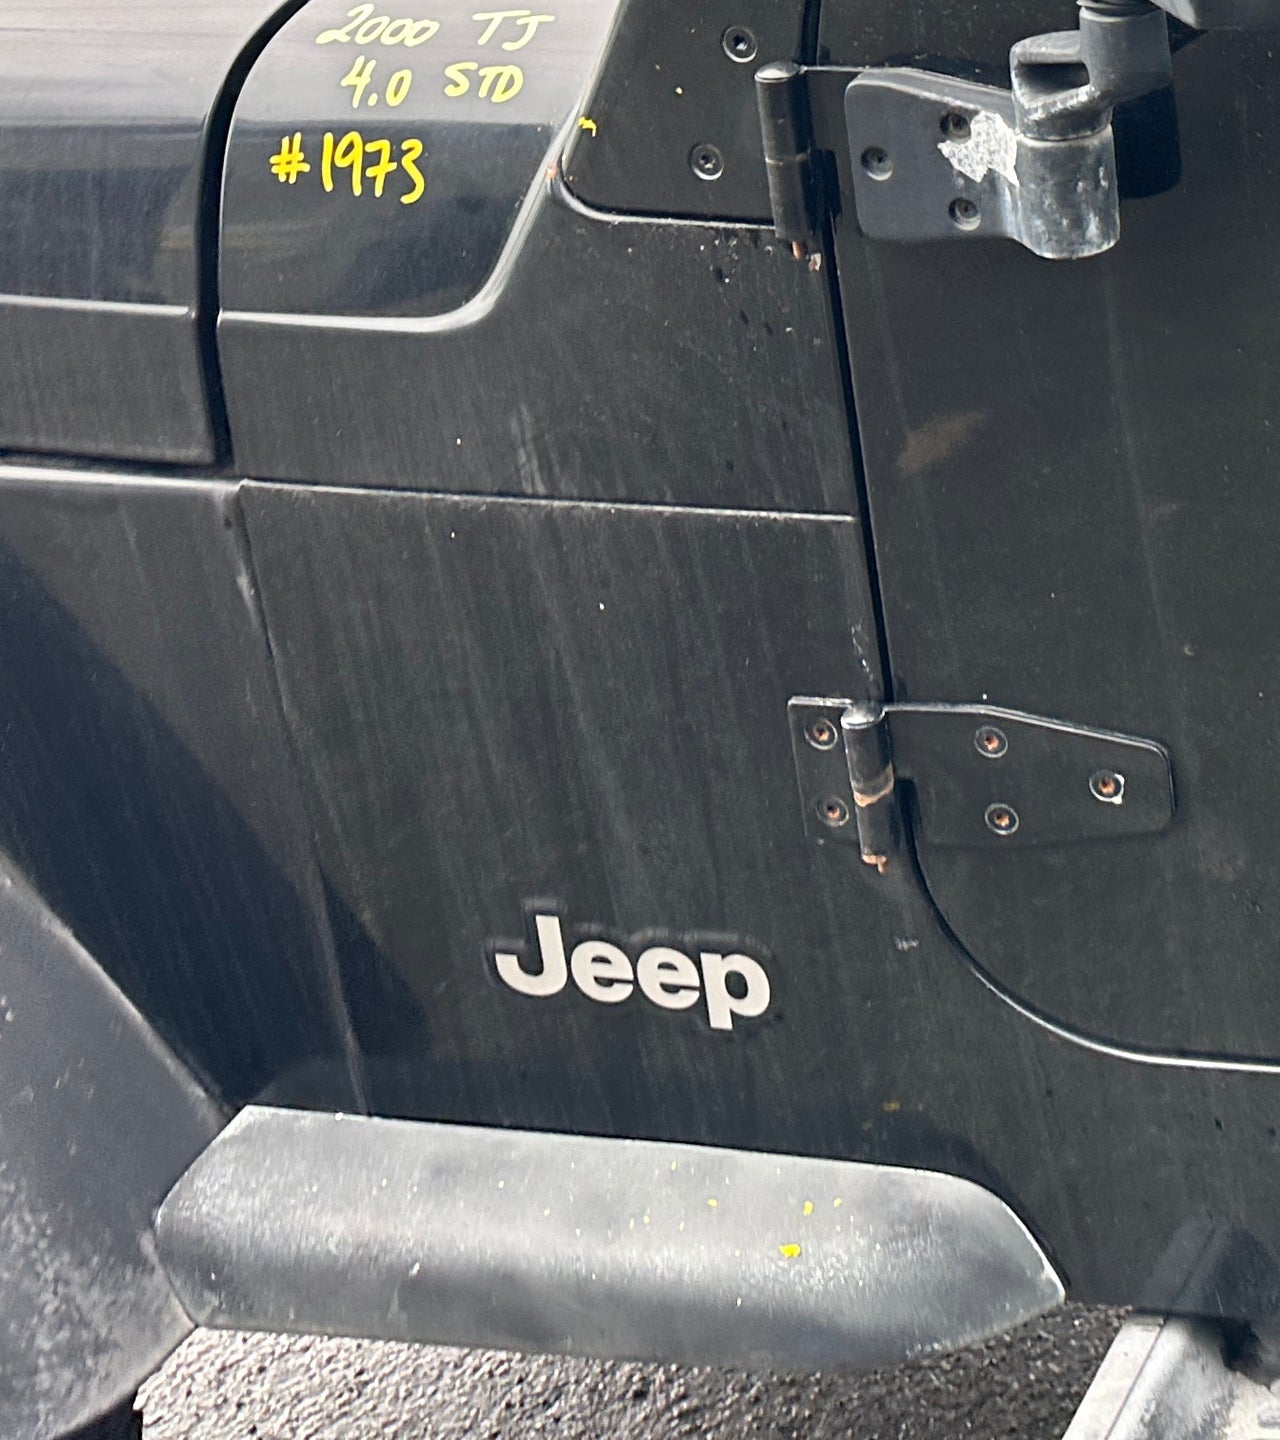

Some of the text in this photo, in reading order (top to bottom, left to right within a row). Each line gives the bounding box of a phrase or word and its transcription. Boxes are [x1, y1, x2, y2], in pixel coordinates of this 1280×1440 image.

[315, 3, 556, 51] 2000 TJ
[340, 55, 525, 109] 4.0 STD
[268, 130, 426, 205] #1973
[495, 914, 771, 1031] Jeep
